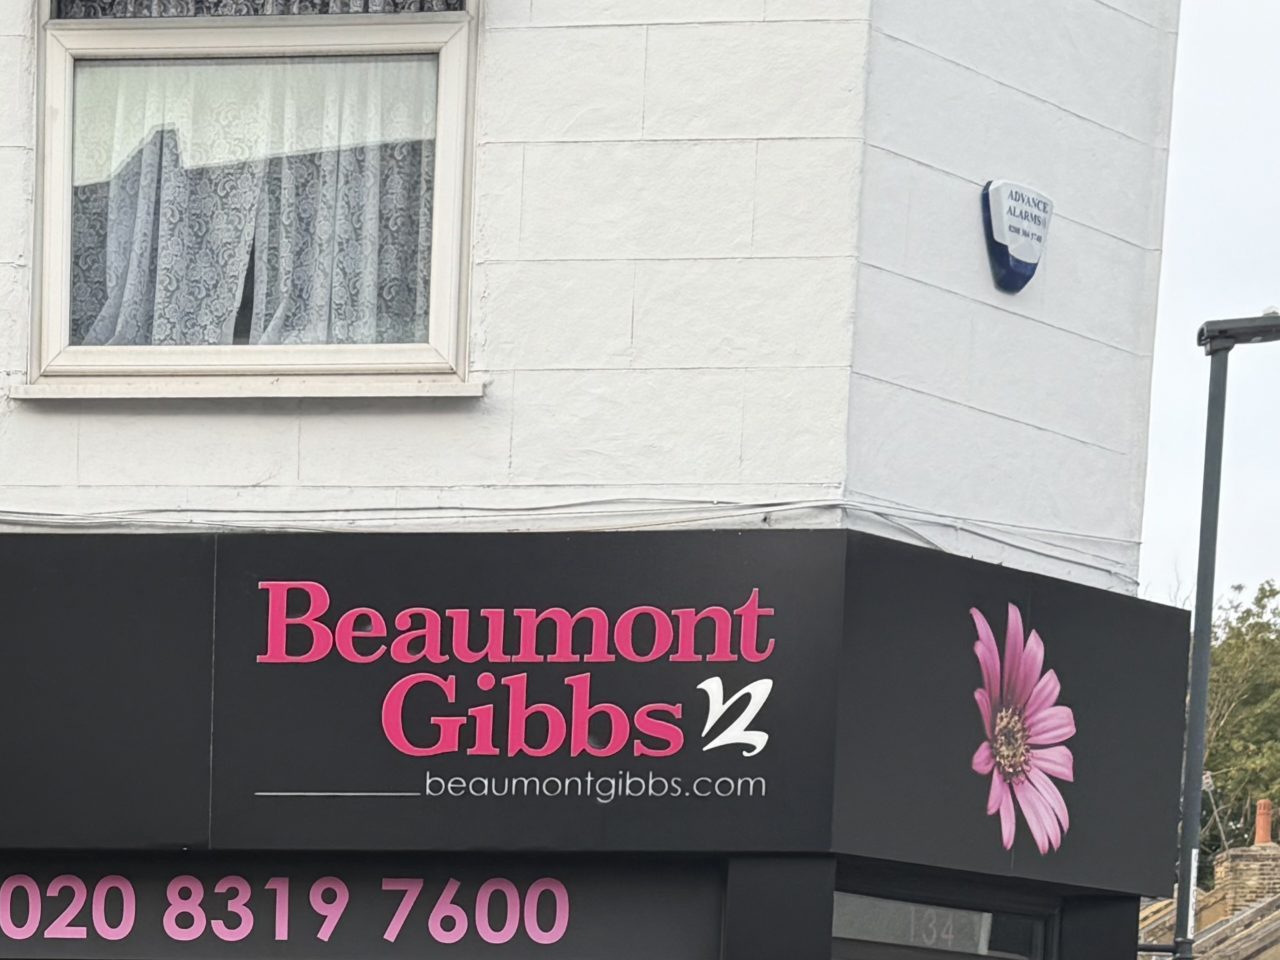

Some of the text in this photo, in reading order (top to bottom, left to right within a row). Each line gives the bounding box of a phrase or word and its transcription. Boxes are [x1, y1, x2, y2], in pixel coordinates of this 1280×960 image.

[1006, 206, 1042, 227] ALARMS
[1008, 189, 1049, 214] ADVANCE
[256, 581, 775, 664] Beaumont
[381, 672, 684, 757] Gibbs
[425, 771, 766, 803] beaumontgibbs.com
[162, 875, 349, 942] 8319
[381, 878, 570, 944] 7600
[909, 906, 956, 948] 134
